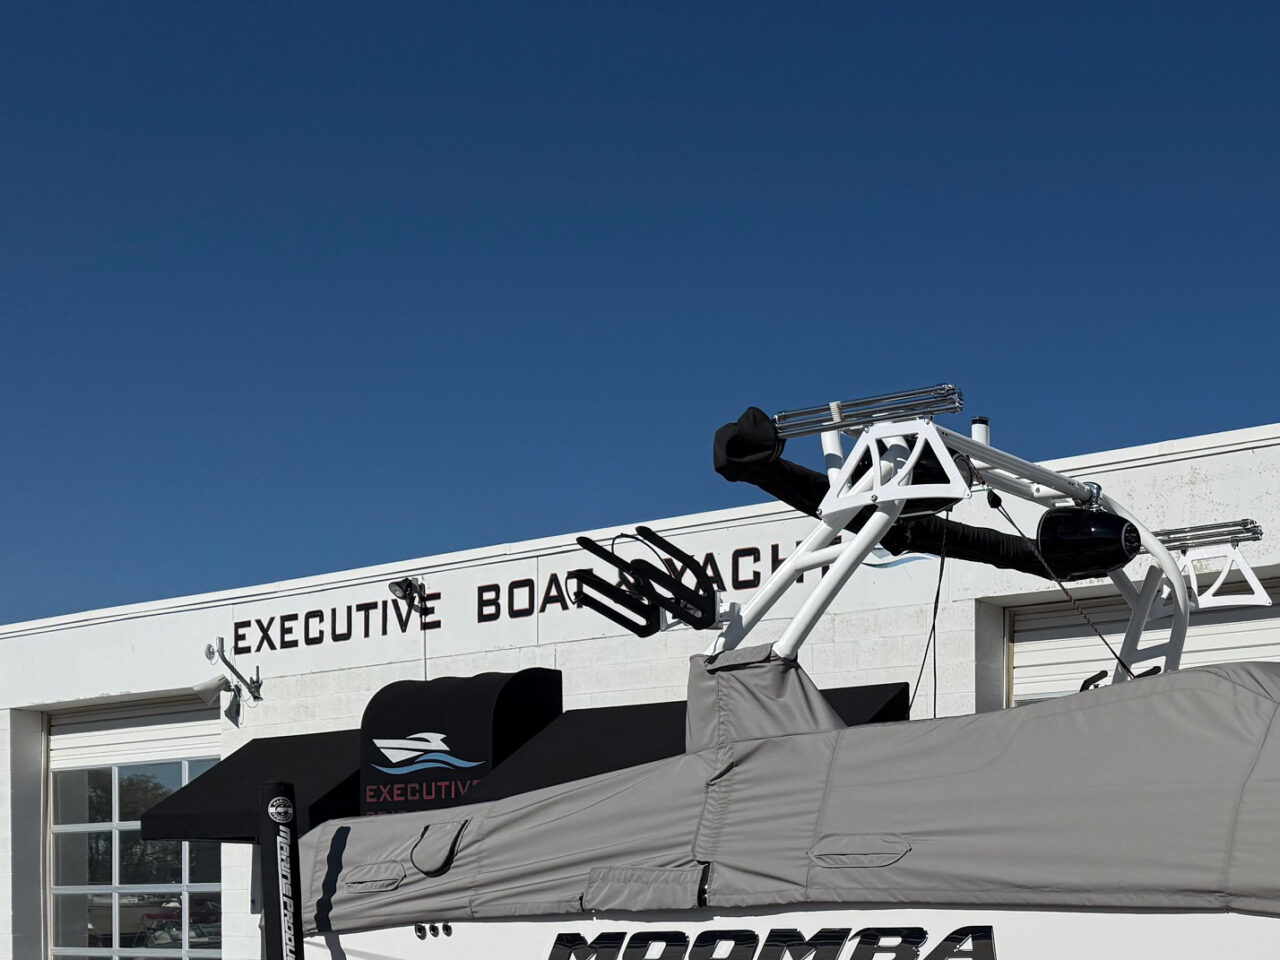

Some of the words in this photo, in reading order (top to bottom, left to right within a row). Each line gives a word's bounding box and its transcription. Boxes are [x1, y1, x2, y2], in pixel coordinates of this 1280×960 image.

[234, 592, 442, 655] EXECUTIVE
[477, 568, 593, 623] BOAT
[366, 780, 481, 803] EXECUTIV
[279, 824, 292, 898] MARINE
